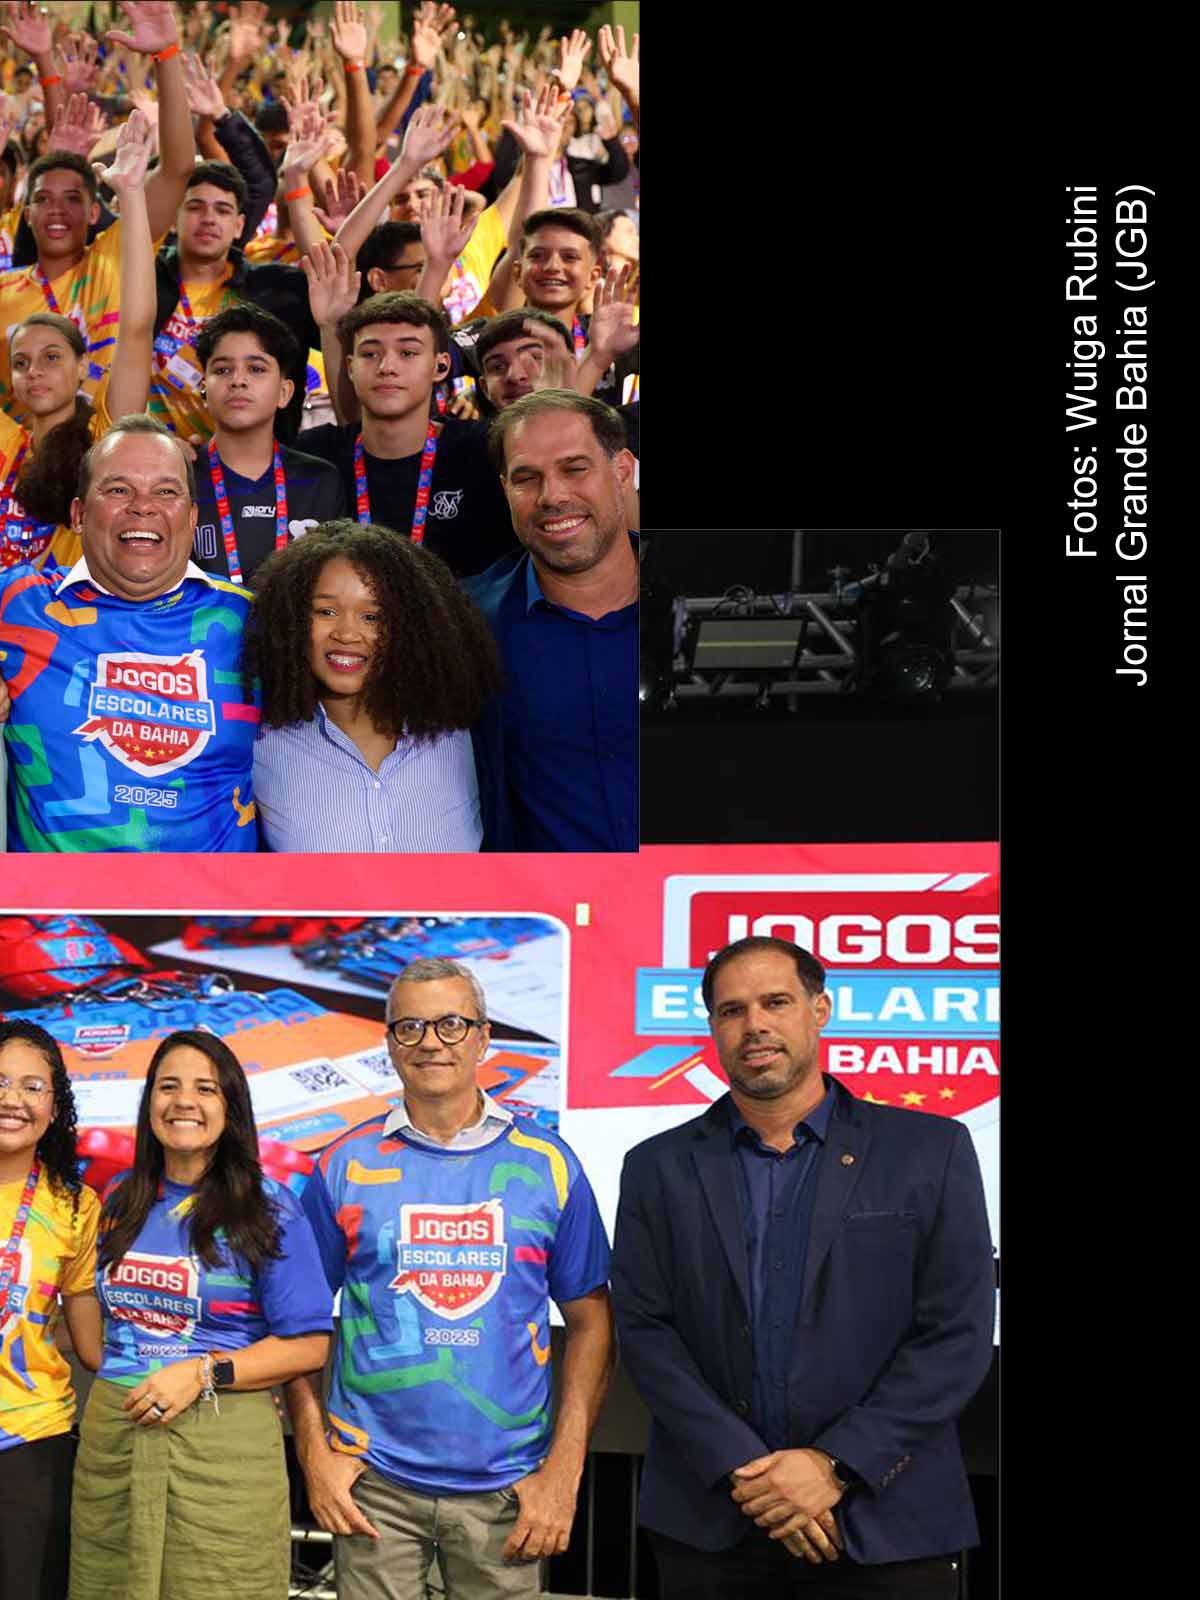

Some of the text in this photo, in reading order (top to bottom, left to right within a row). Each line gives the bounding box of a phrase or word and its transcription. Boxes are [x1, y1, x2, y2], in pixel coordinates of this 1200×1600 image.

[111, 668, 193, 695] JOGOS
[95, 694, 208, 723] ESCOLARES
[112, 721, 190, 747] DA BAHIA
[114, 785, 178, 808] 2025
[828, 1045, 999, 1075] BAHIA
[413, 1219, 489, 1241] JOGOS
[403, 1250, 501, 1266] ESCOLARES
[111, 1263, 184, 1291] JOGOS
[420, 1273, 485, 1287] DA BAHIA
[106, 1290, 195, 1315] ESCOLARES
[424, 1327, 480, 1346] 2025
